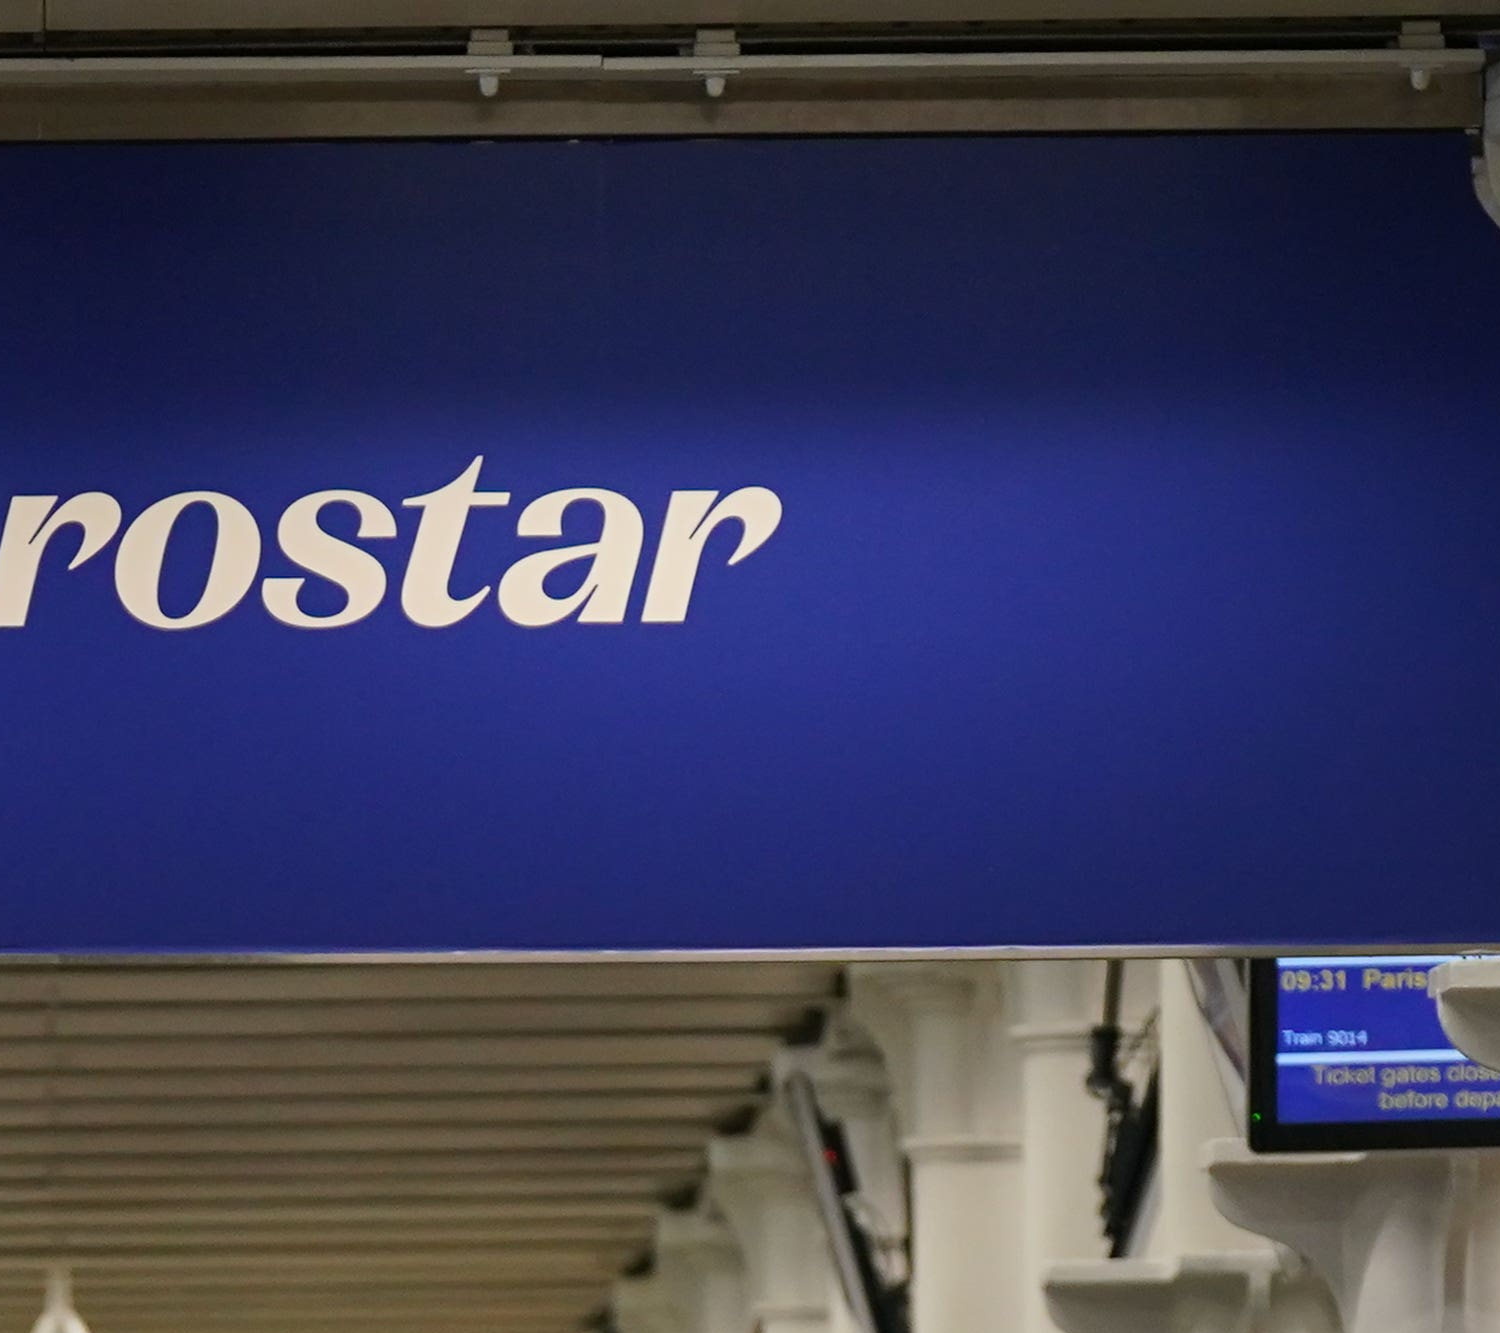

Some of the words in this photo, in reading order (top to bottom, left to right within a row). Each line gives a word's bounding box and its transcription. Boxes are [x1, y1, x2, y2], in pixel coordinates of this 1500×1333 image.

[1280, 969, 1347, 992] 09:31
[1362, 968, 1428, 990] Paris
[1282, 1029, 1324, 1046] Train
[1327, 1029, 1369, 1047] 9014
[1312, 1066, 1376, 1086] Ticket
[1380, 1065, 1441, 1088] gates
[1379, 1091, 1449, 1111] before
